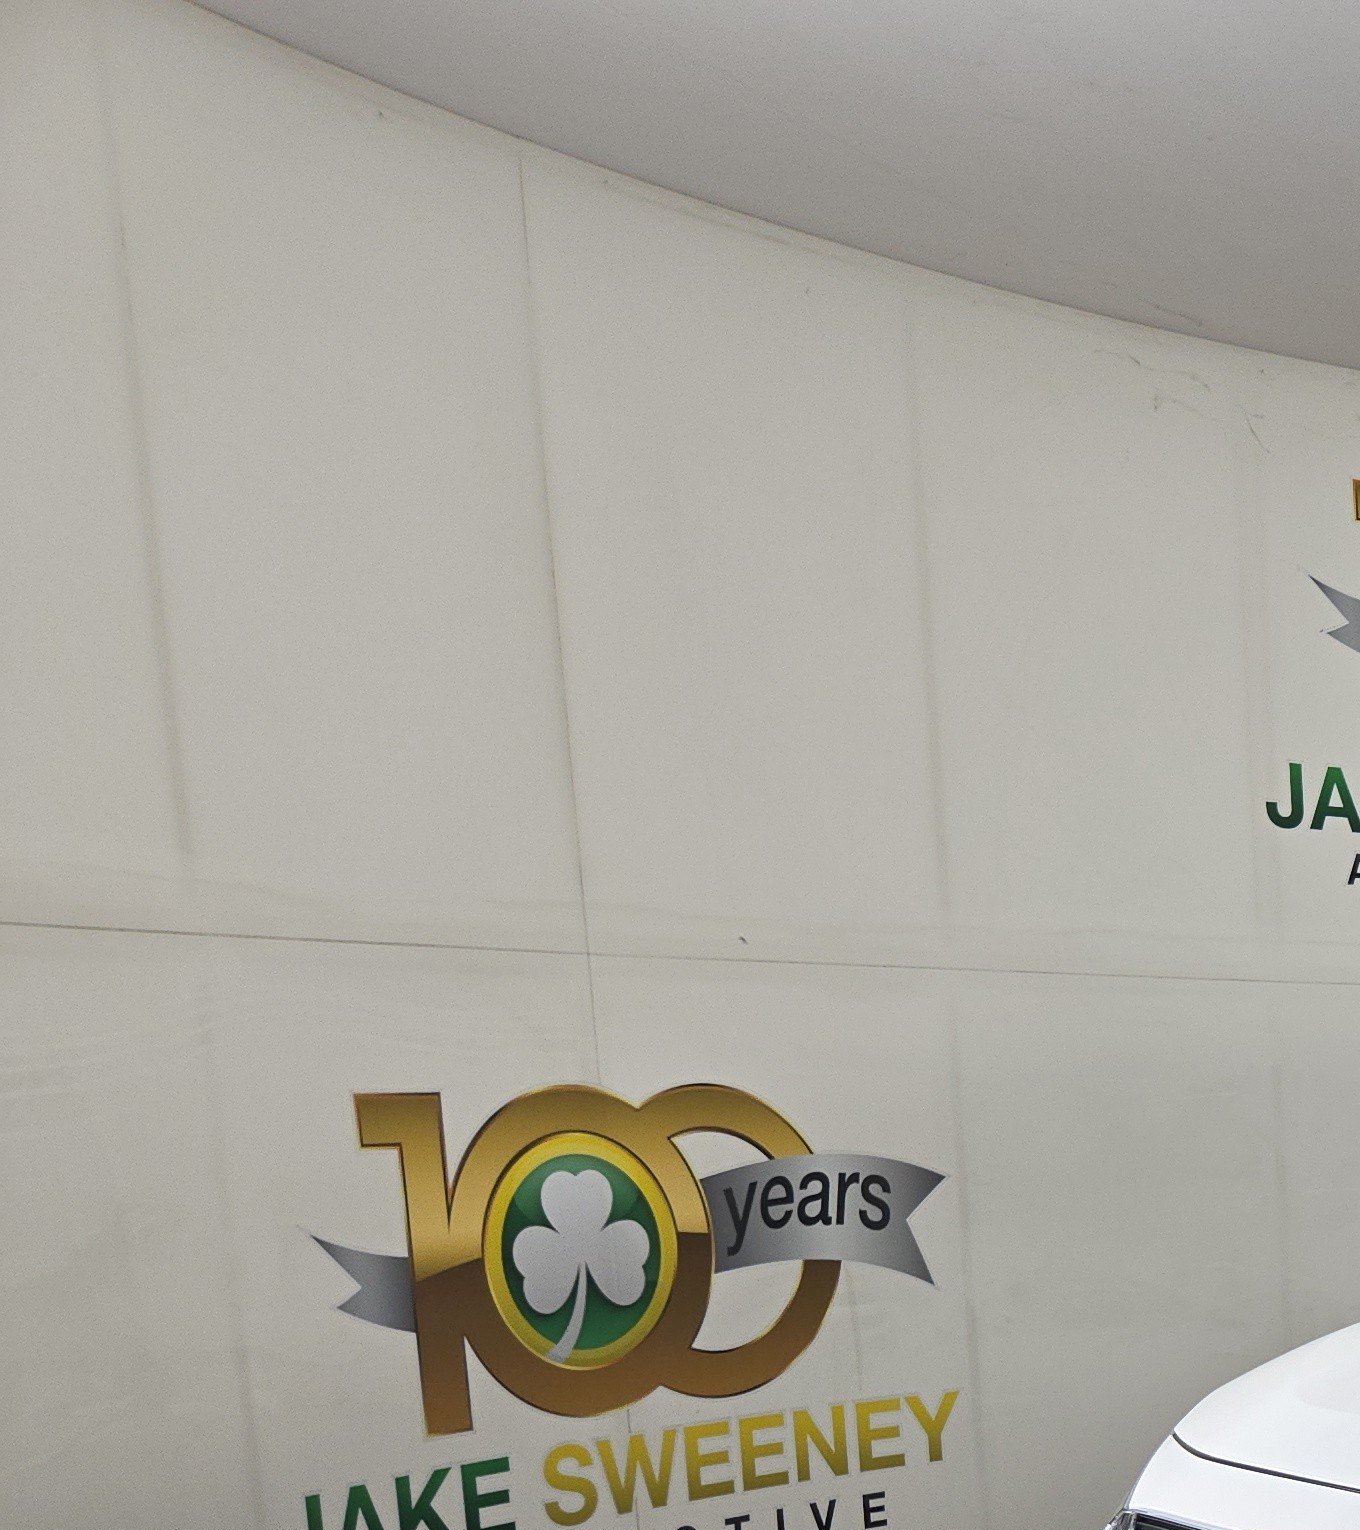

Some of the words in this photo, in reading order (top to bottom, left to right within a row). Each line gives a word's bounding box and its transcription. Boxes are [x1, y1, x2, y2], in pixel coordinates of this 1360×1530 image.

[353, 1082, 841, 1437] 100
[723, 1170, 891, 1257] years
[543, 1390, 959, 1527] SWEENEY
